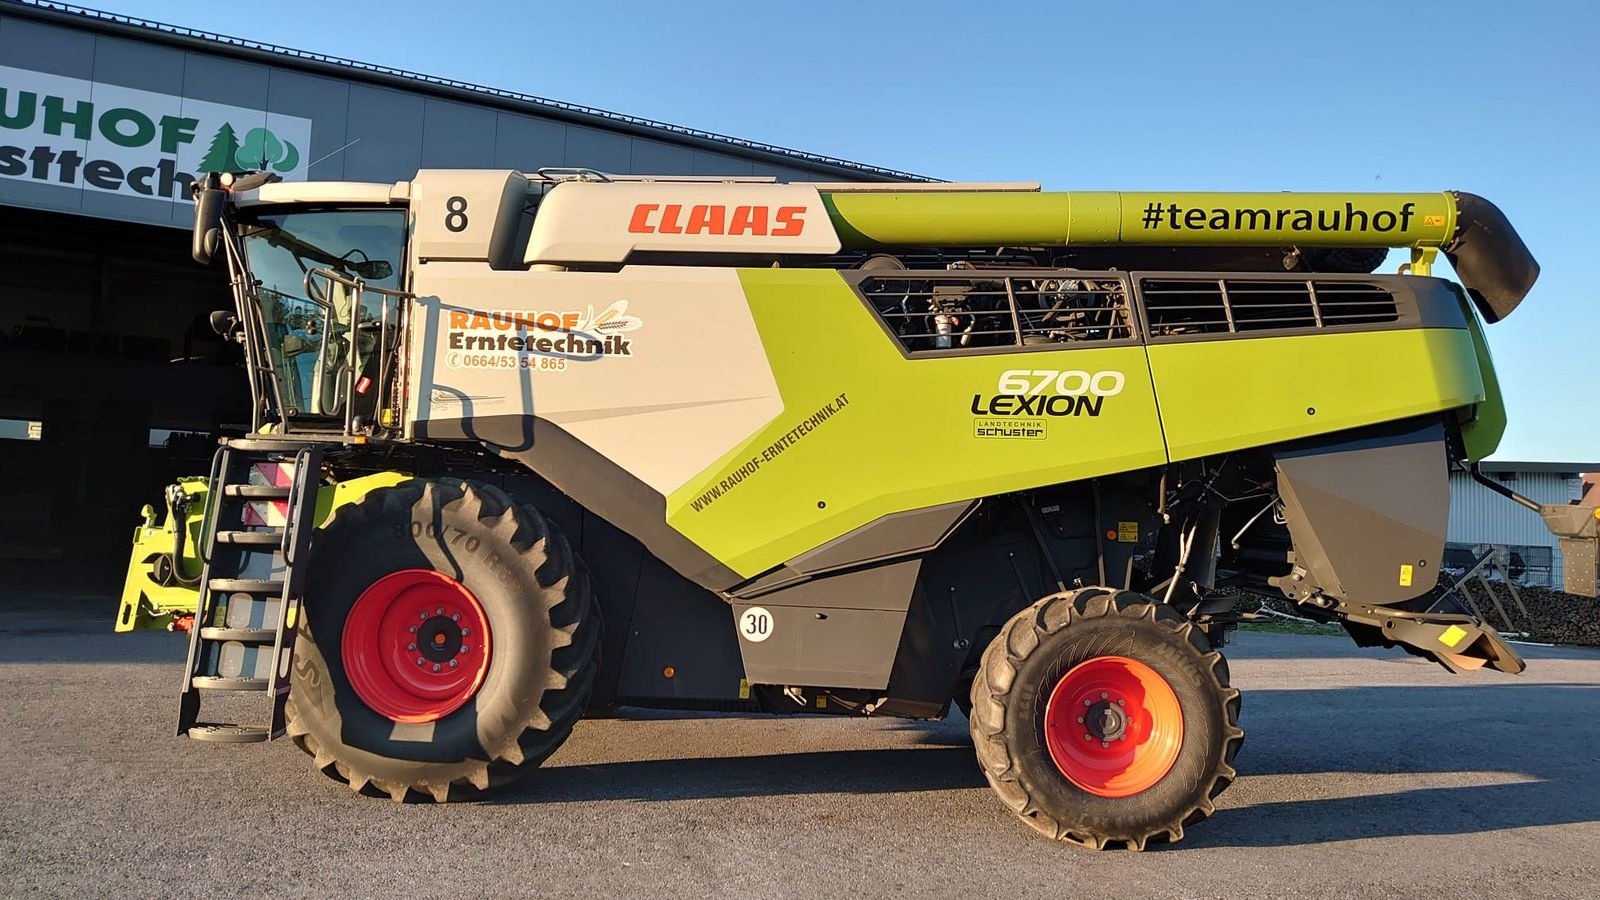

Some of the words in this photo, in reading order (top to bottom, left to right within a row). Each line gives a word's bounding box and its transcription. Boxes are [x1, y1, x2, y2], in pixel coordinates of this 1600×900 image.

[445, 196, 469, 233] 8
[628, 203, 807, 237] CLAAS
[1142, 202, 1416, 232] #teamrauhof
[450, 311, 580, 333] RAUHOF
[449, 331, 631, 355] Erntetechnik
[463, 354, 516, 368] 0664/53
[521, 356, 537, 369] 54
[541, 357, 566, 370] 865
[998, 369, 1126, 397] 6700
[970, 394, 1104, 417] LEXION
[977, 427, 1044, 438] schuster
[690, 392, 851, 513] WWW.RAUHOF-ERNTETECHNIK.AT
[745, 613, 768, 635] 30
